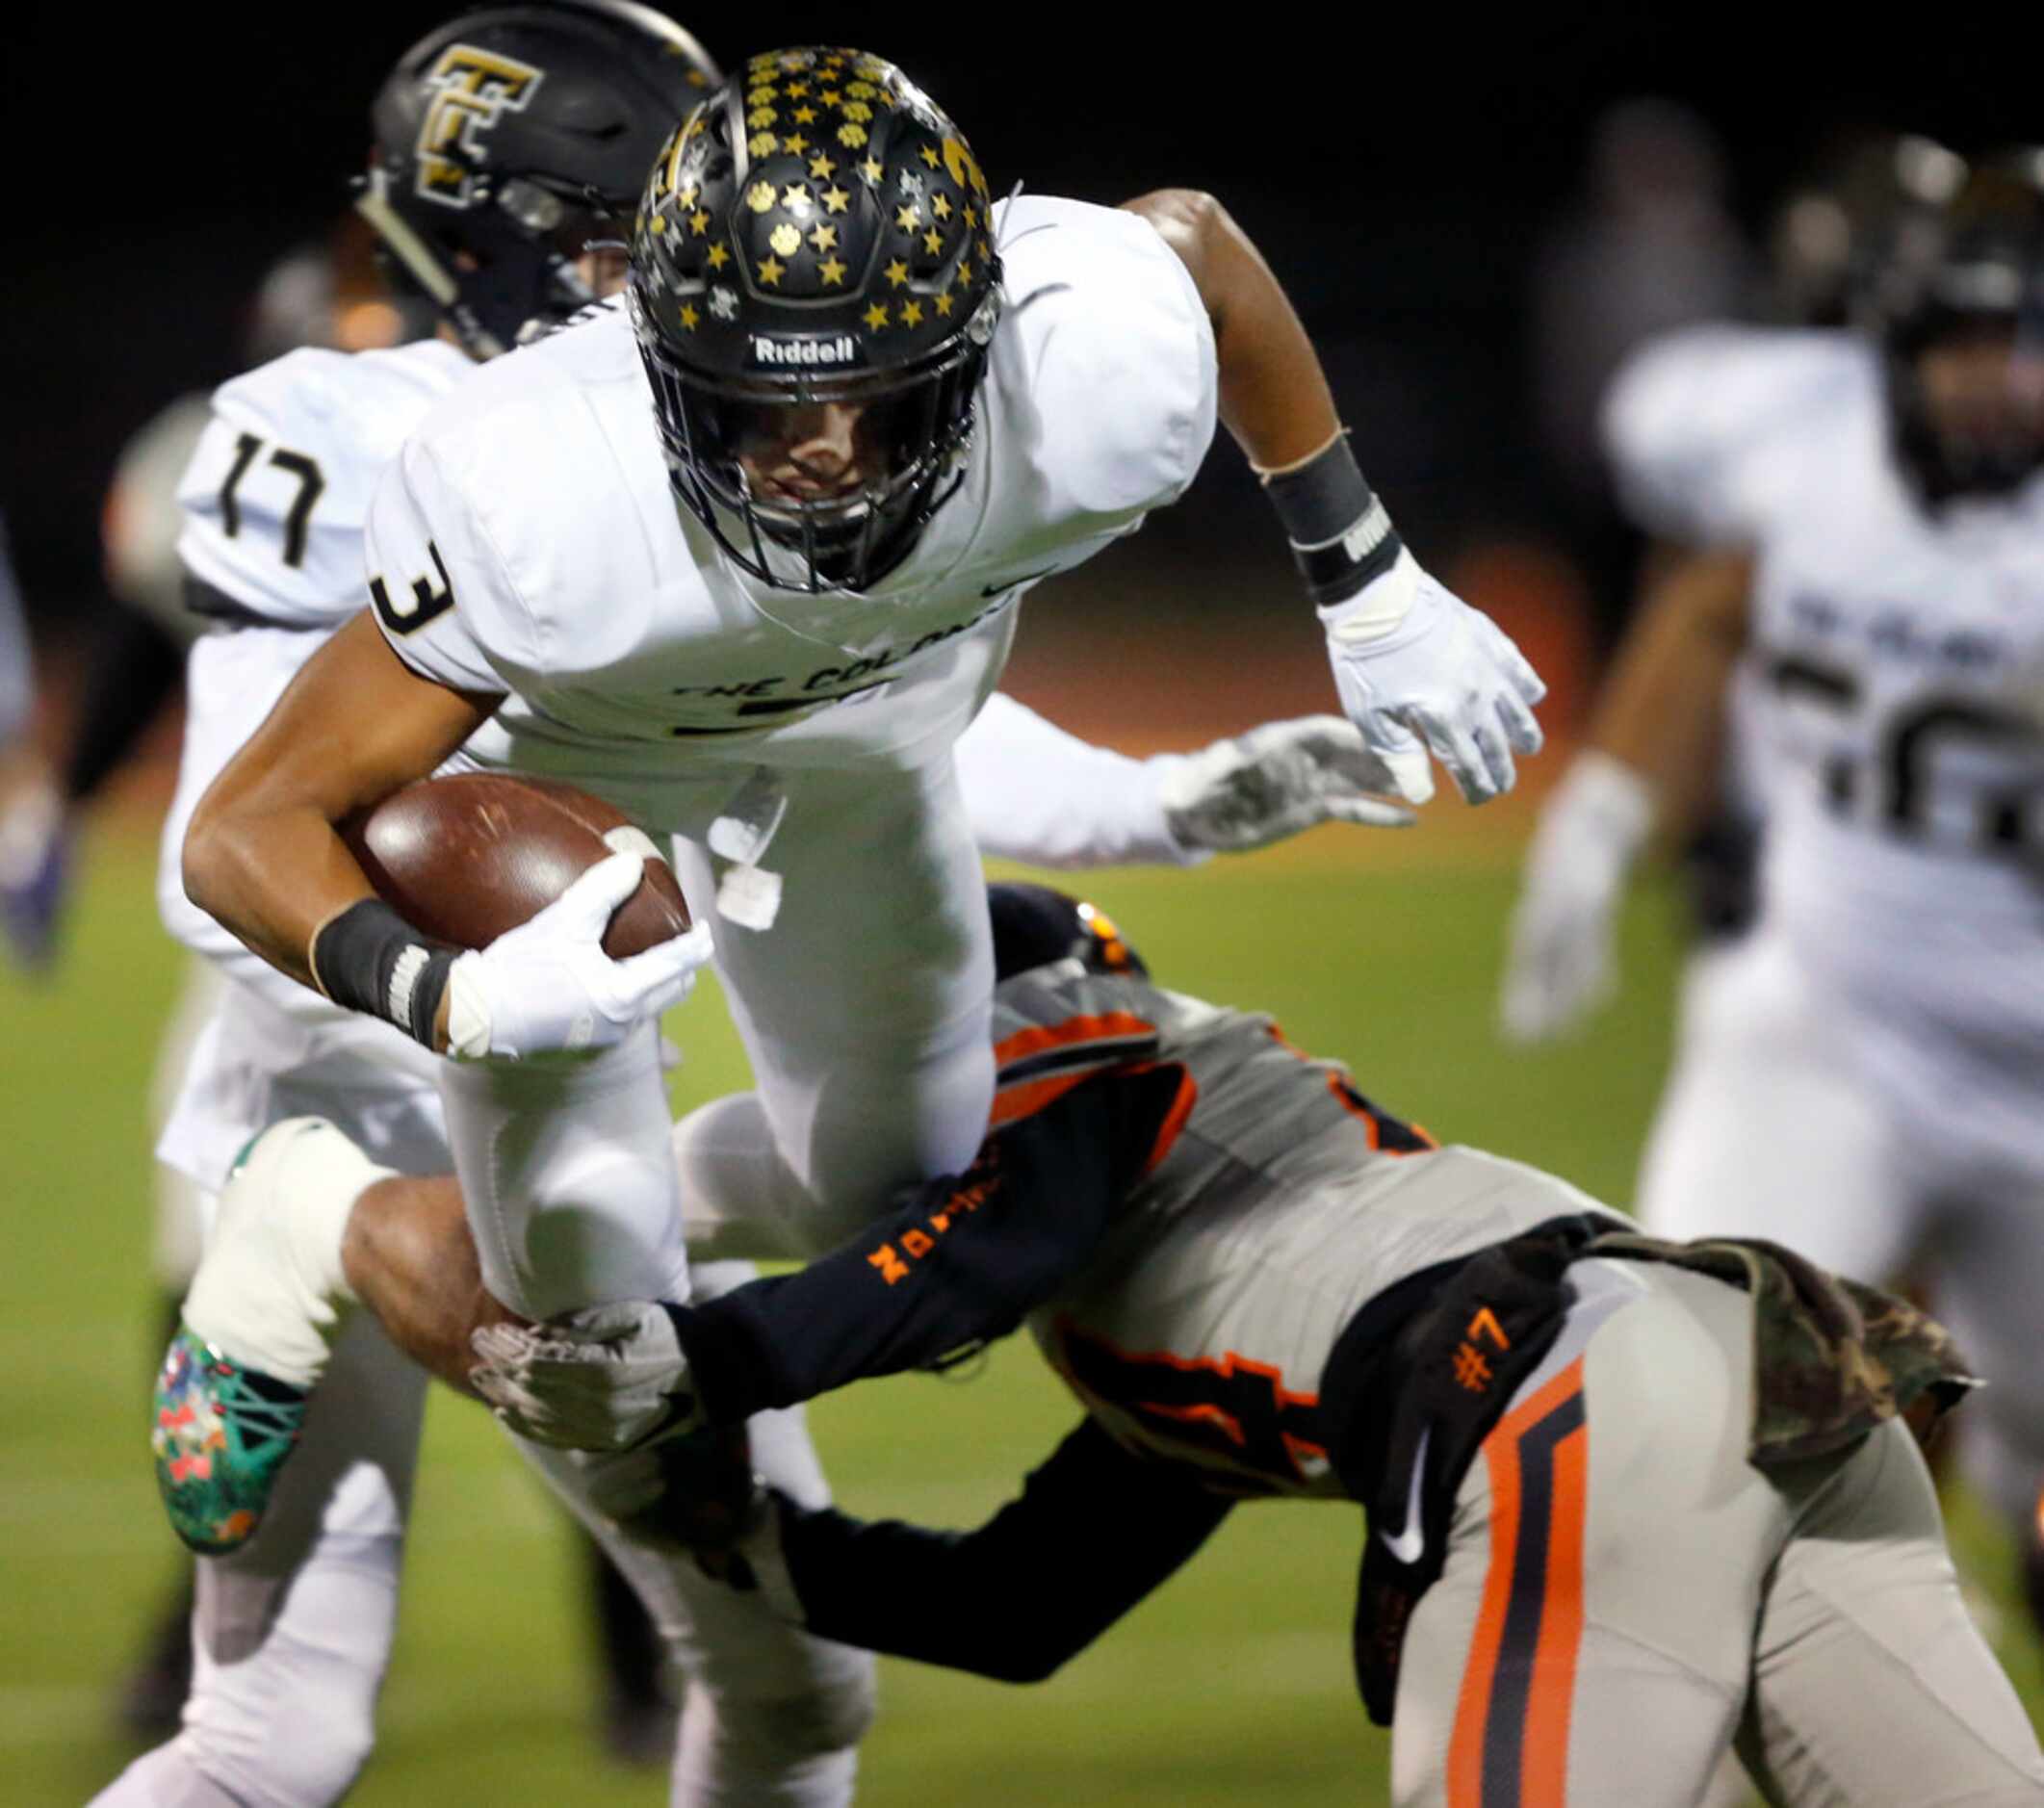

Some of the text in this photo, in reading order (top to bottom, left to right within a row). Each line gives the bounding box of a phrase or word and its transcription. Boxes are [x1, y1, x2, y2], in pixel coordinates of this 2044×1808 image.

[755, 335, 855, 364] Riddell
[218, 431, 326, 569] 17
[370, 539, 455, 638] 3
[1451, 1305, 1511, 1393] #7
